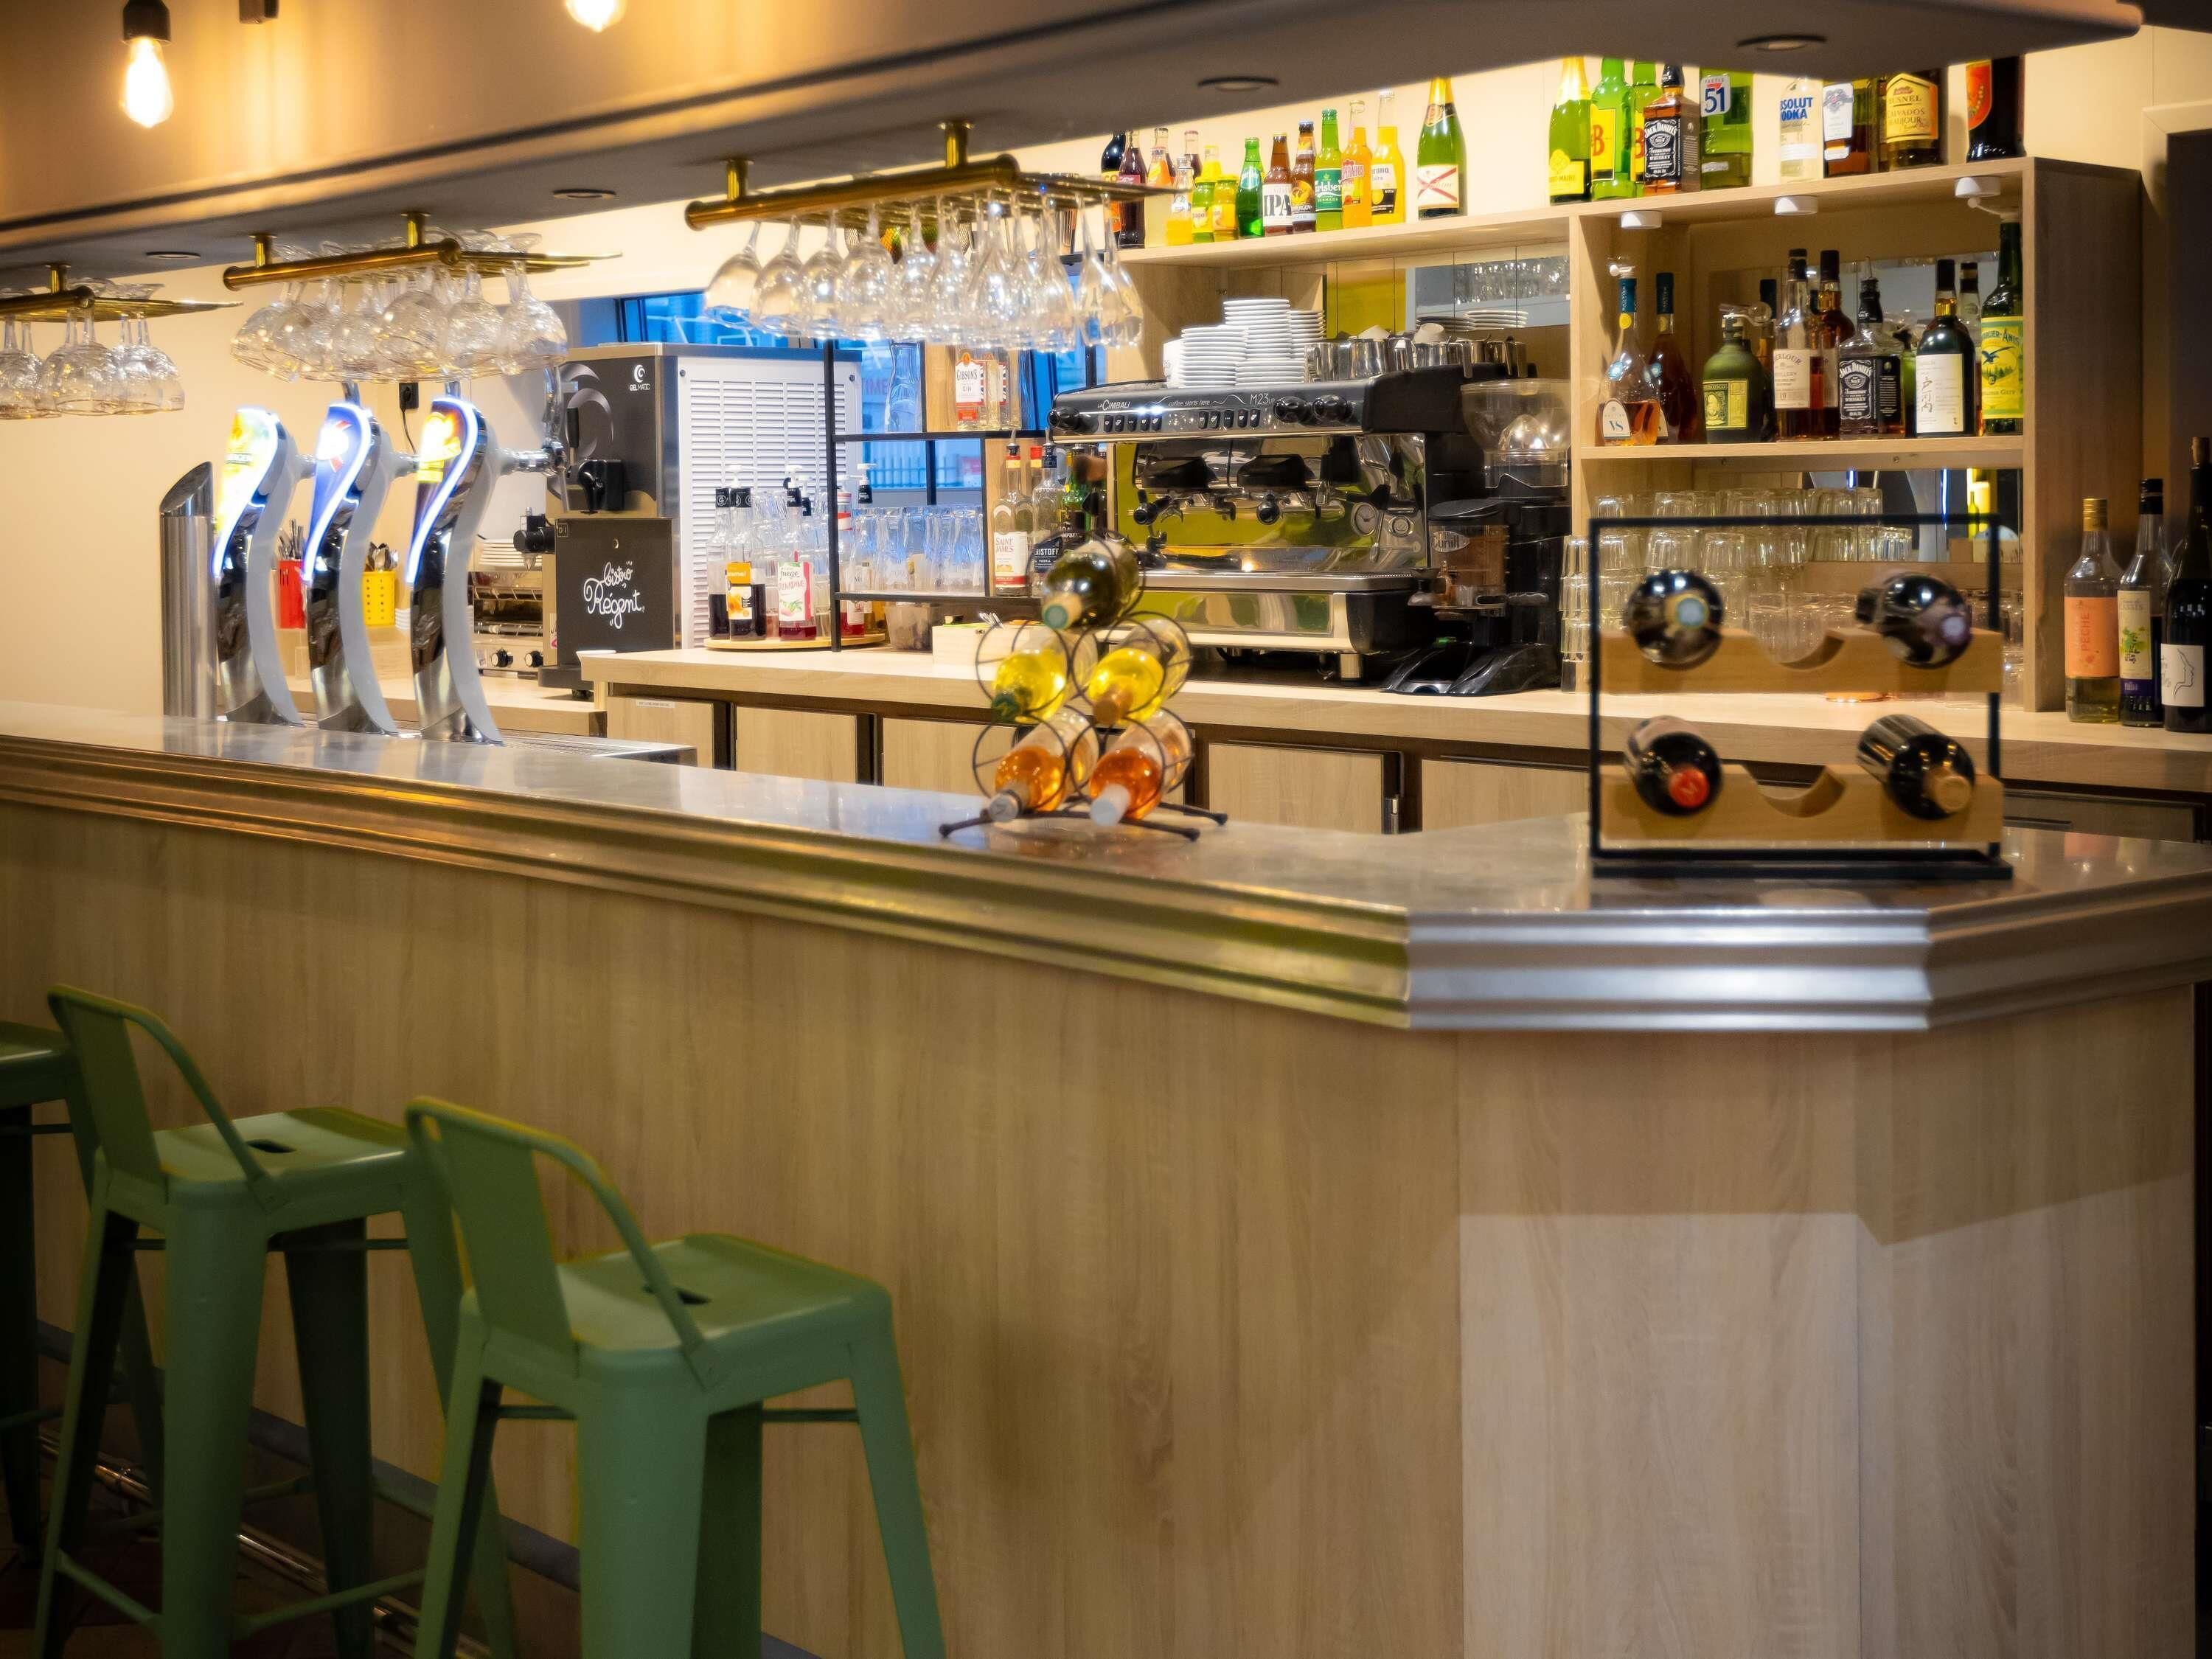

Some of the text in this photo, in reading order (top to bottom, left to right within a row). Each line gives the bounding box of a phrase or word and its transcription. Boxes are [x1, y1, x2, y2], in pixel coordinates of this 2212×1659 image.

[1704, 87, 1725, 113] 51
[1781, 108, 1808, 121] ODKA
[1644, 124, 1658, 139] JACK
[1263, 195, 1291, 217] IPA
[1839, 365, 1852, 378] JACK
[1102, 399, 1131, 411] CIMBALI
[1250, 393, 1269, 406] M23
[995, 538, 1015, 546] SAINT
[604, 562, 633, 587] bistro
[583, 578, 642, 629] Régent
